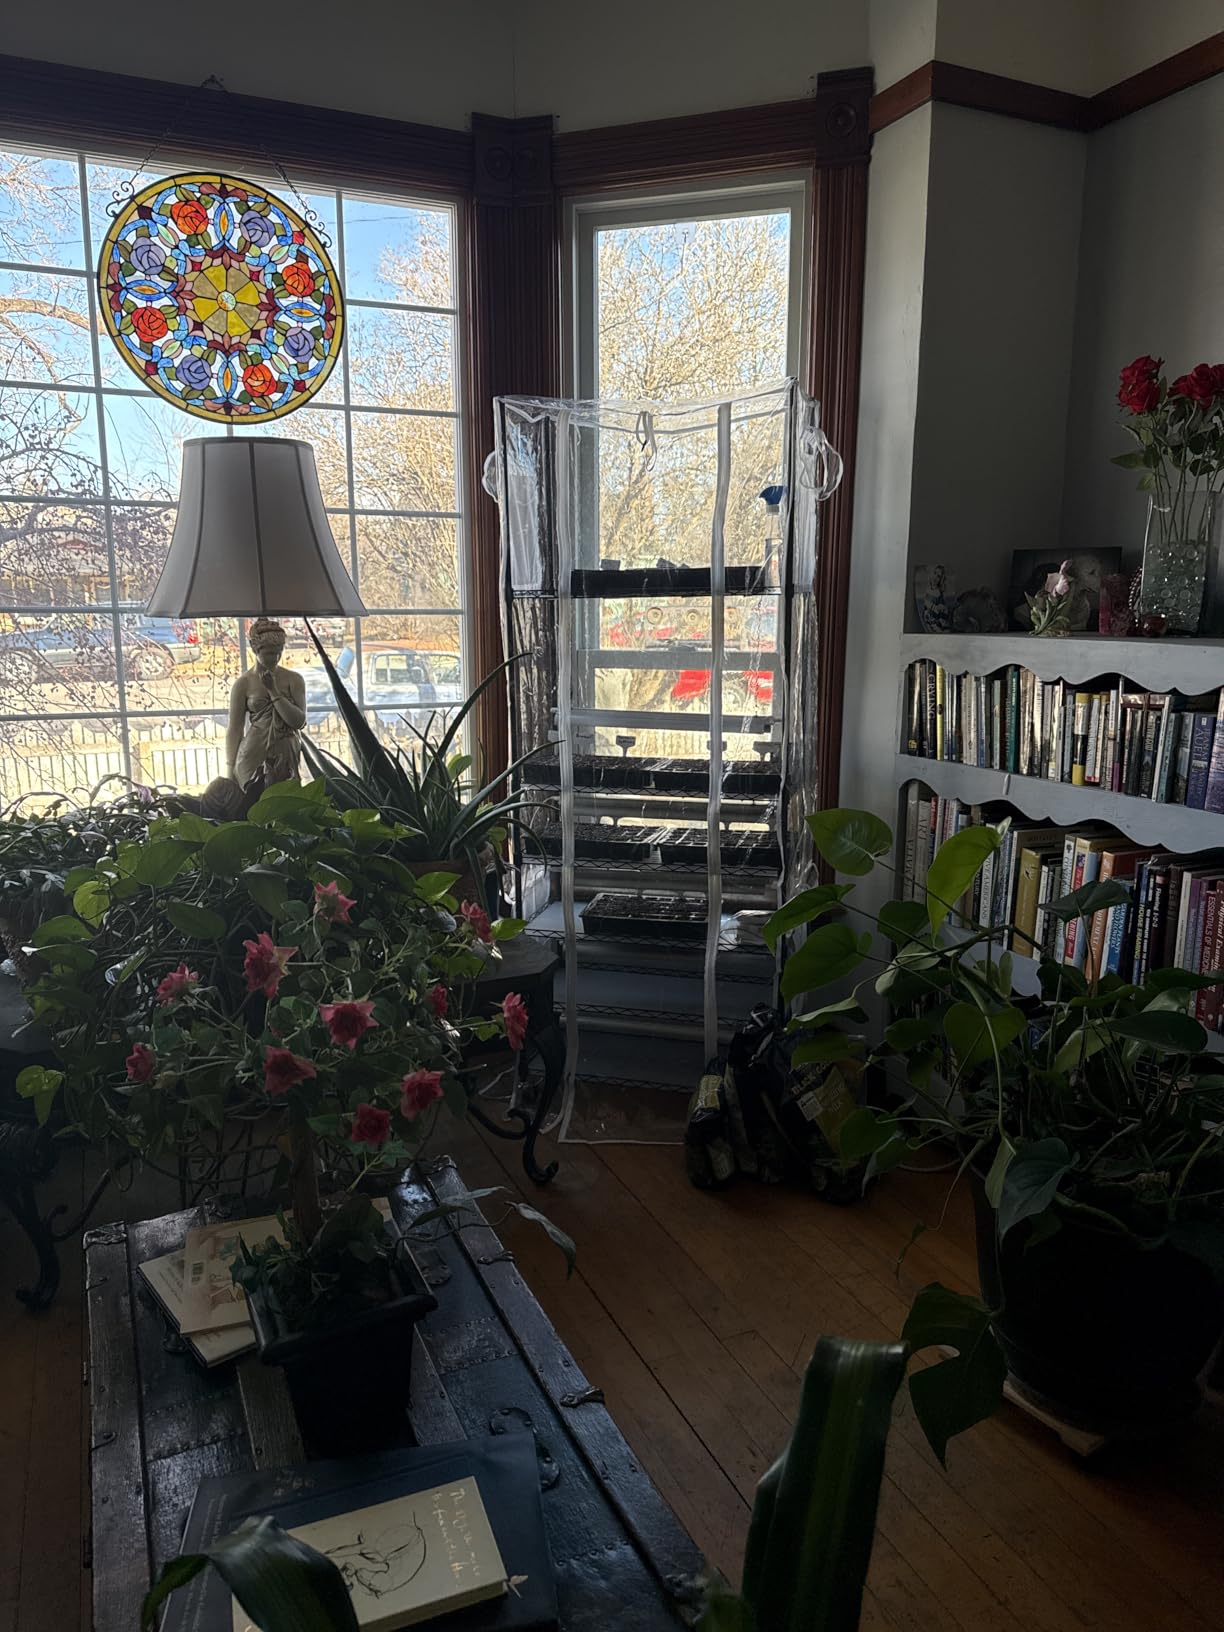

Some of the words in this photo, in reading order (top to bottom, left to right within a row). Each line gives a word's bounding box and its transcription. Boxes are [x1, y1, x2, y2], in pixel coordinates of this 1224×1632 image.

[1193, 727, 1204, 760] AUEL
[1137, 904, 1145, 927] HOUSE
[1204, 895, 1216, 936] ESSENTIALS
[1133, 927, 1143, 960] FRAMING
